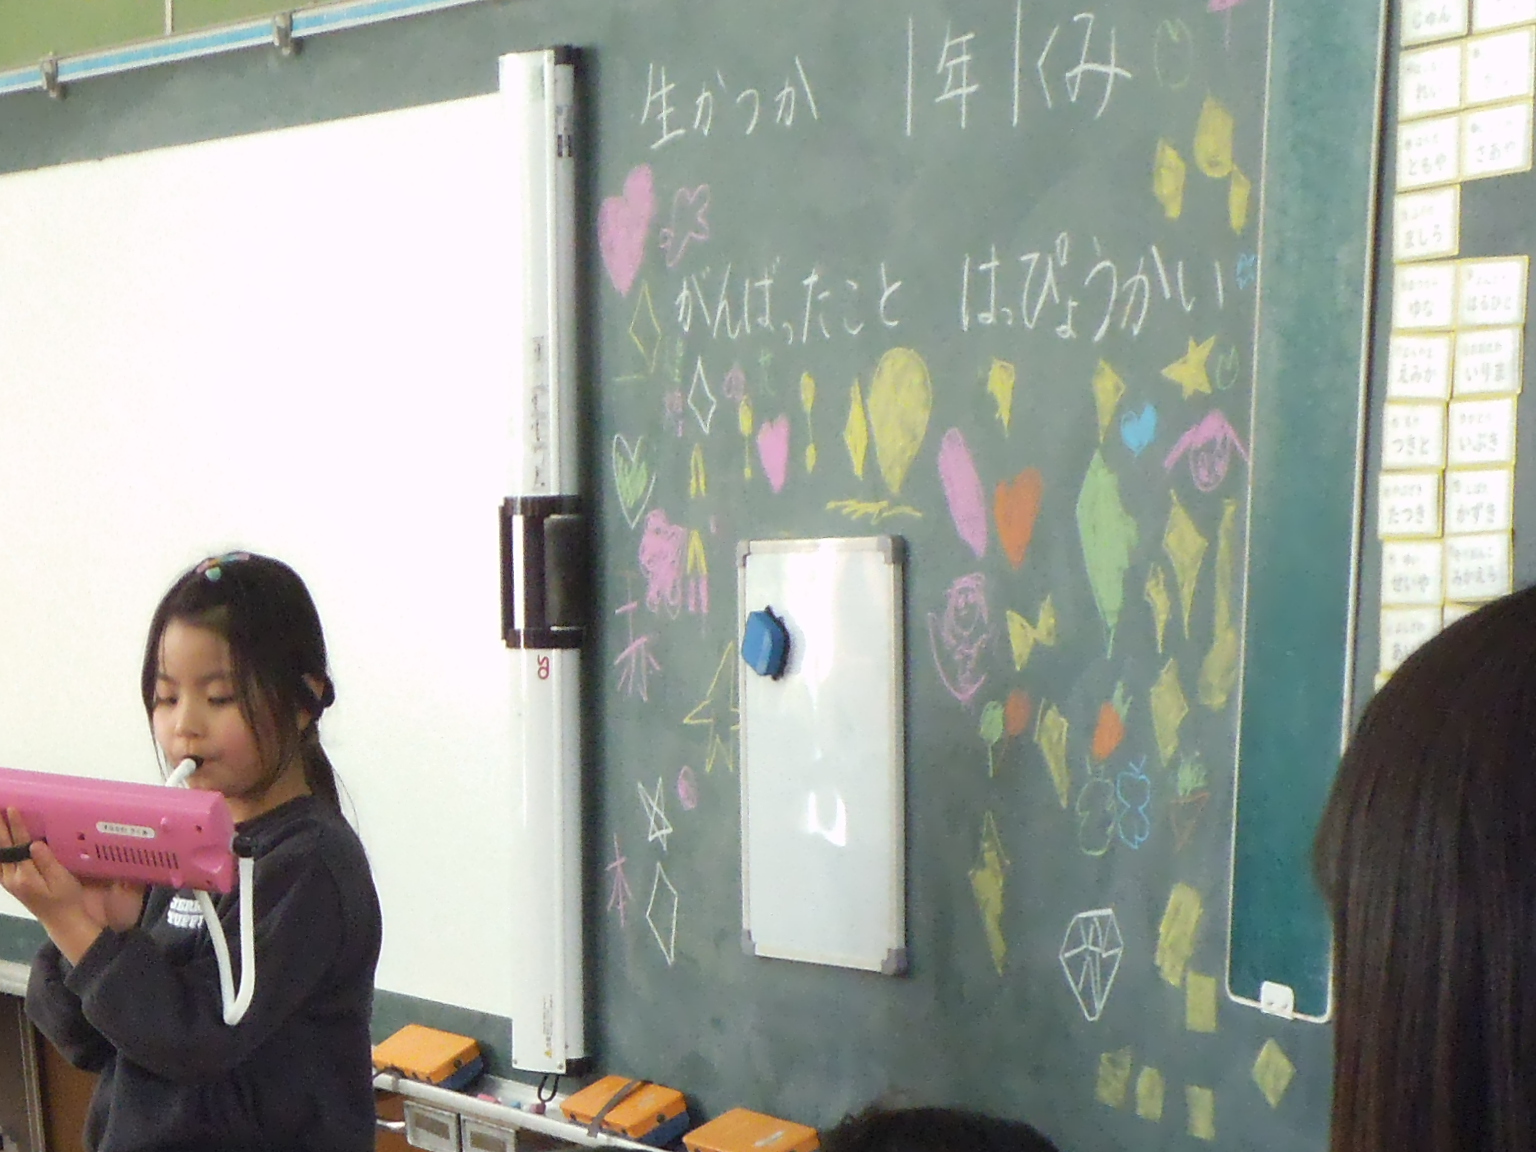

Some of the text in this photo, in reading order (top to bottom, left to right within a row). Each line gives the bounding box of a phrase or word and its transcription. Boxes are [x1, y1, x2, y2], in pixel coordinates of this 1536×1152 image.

[640, 54, 819, 150] 生かつか
[674, 230, 1224, 345] がんばったこと はっぴょうかい
